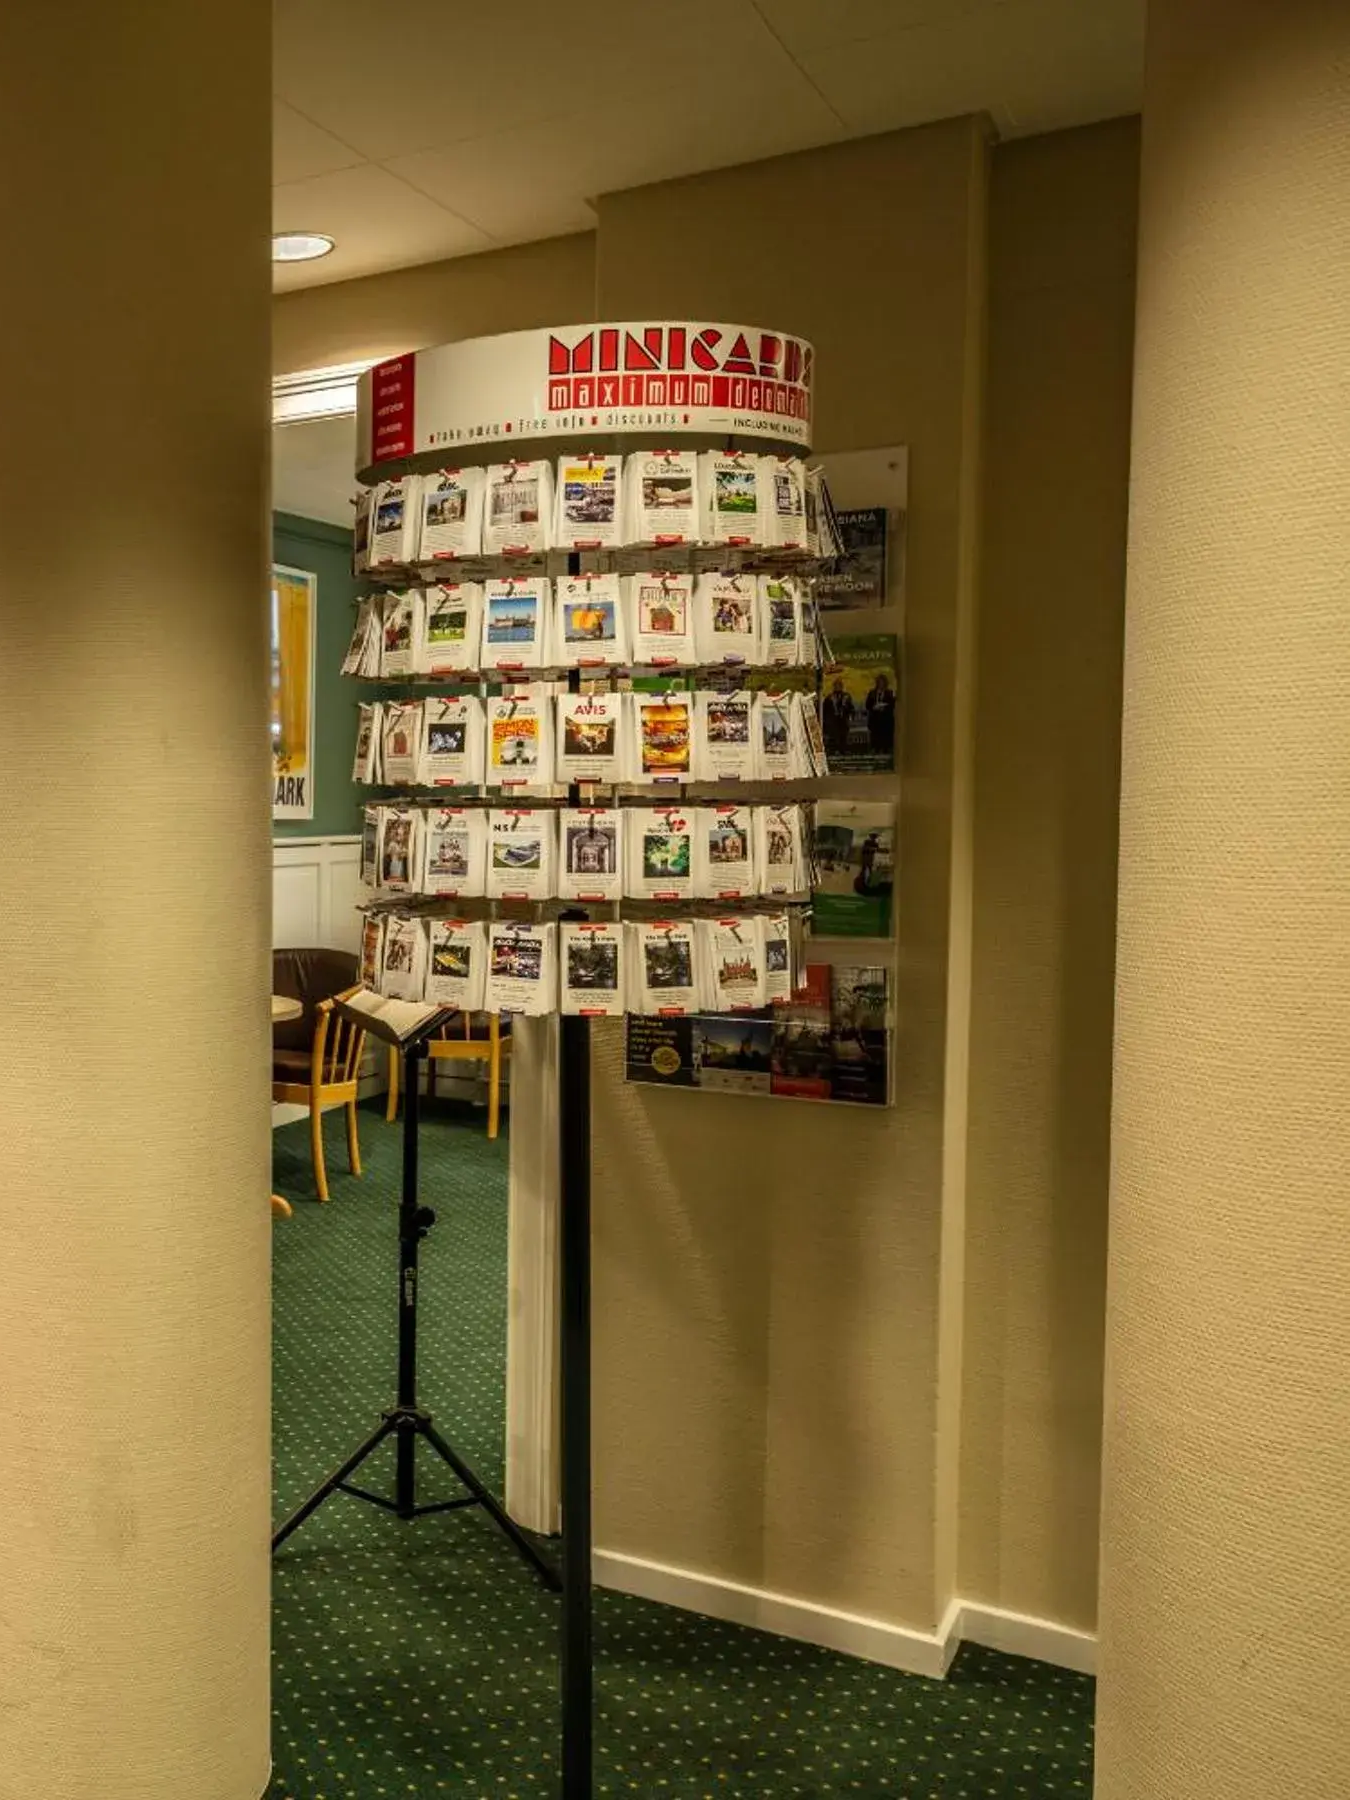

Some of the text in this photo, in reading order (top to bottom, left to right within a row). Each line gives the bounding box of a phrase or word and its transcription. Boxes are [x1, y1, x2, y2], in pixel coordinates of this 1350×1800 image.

[549, 326, 811, 388] MINICARDS
[551, 377, 710, 408] maximum
[574, 704, 606, 716] AVIS
[274, 775, 306, 807] ARK
